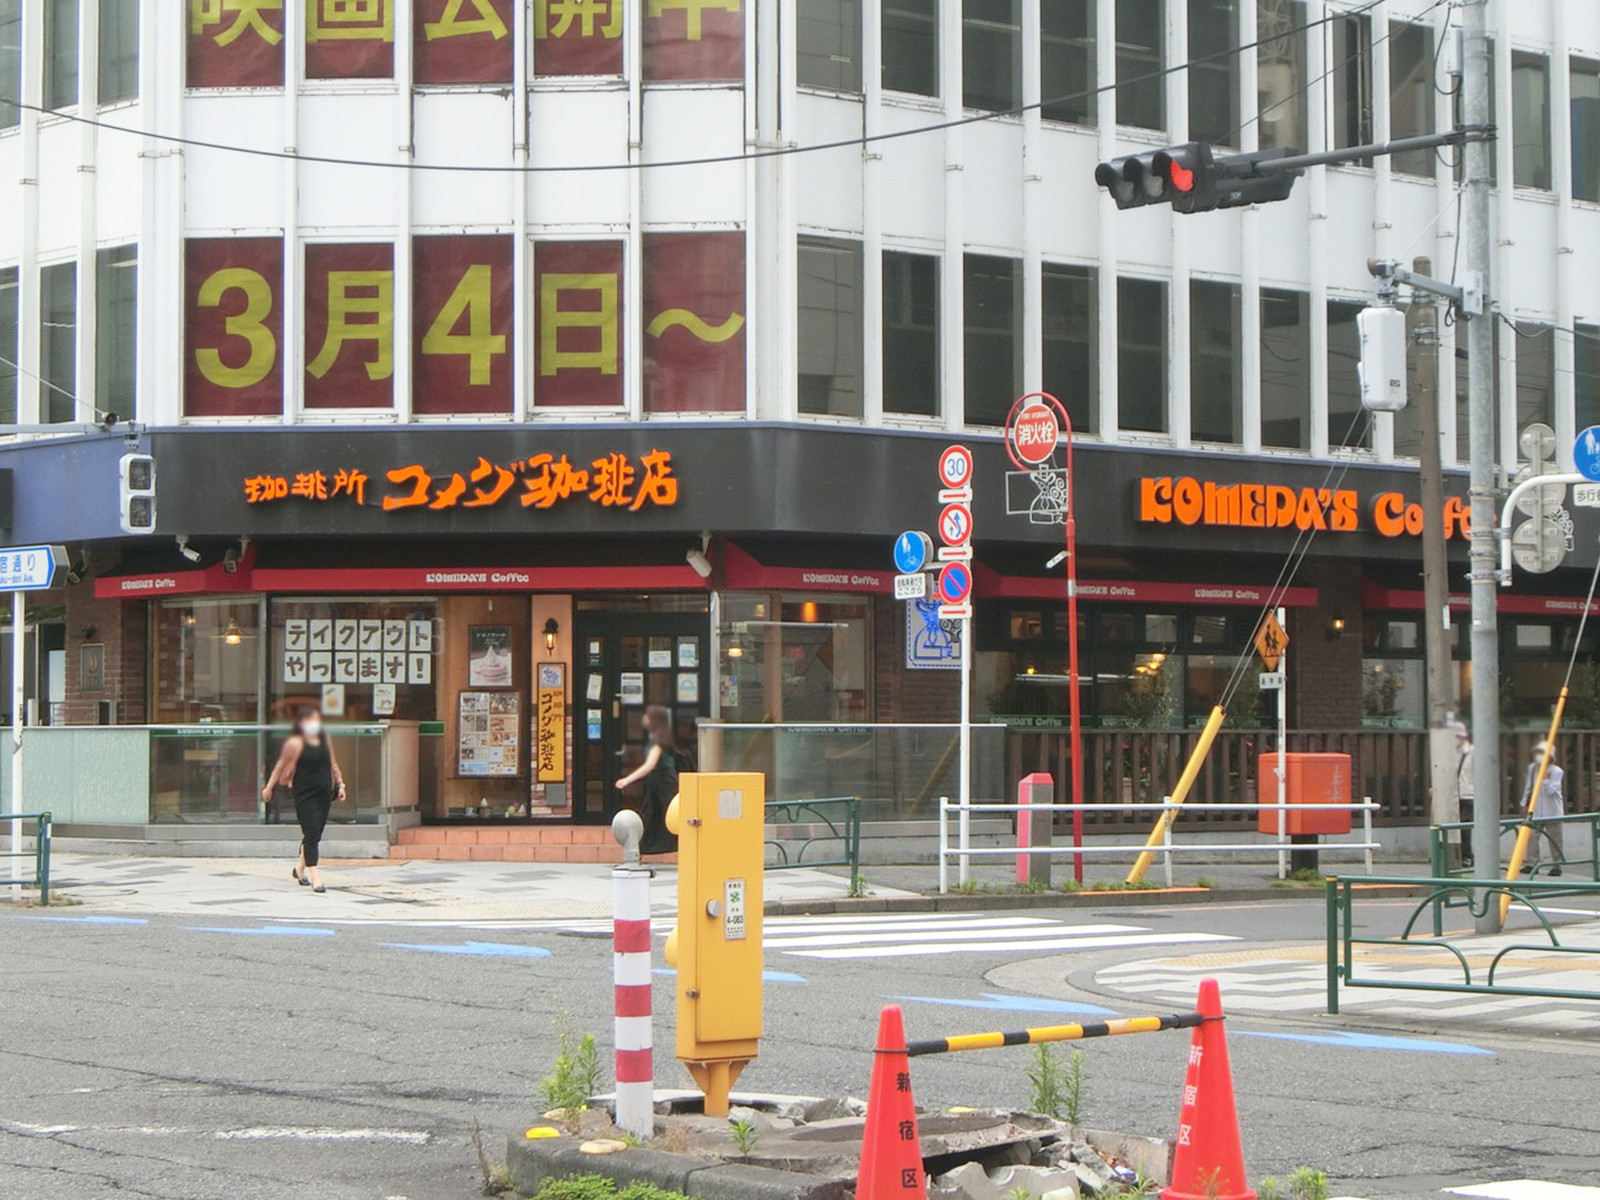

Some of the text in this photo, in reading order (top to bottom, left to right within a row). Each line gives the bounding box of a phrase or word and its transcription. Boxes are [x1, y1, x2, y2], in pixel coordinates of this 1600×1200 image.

[1018, 420, 1055, 446] 消火栓
[244, 448, 678, 511] 珈琲所 コメダ珈琲店
[947, 458, 966, 477] 30
[1141, 476, 1358, 531] KOMEDA'S
[426, 572, 530, 583] KOMEDA'S Coffee
[1074, 585, 1107, 595] OMEDA'S
[288, 624, 429, 647] テイクアウト
[286, 655, 424, 680] やってます！
[1178, 1044, 1203, 1147] 新宿区
[896, 1073, 918, 1189] 新宿区
